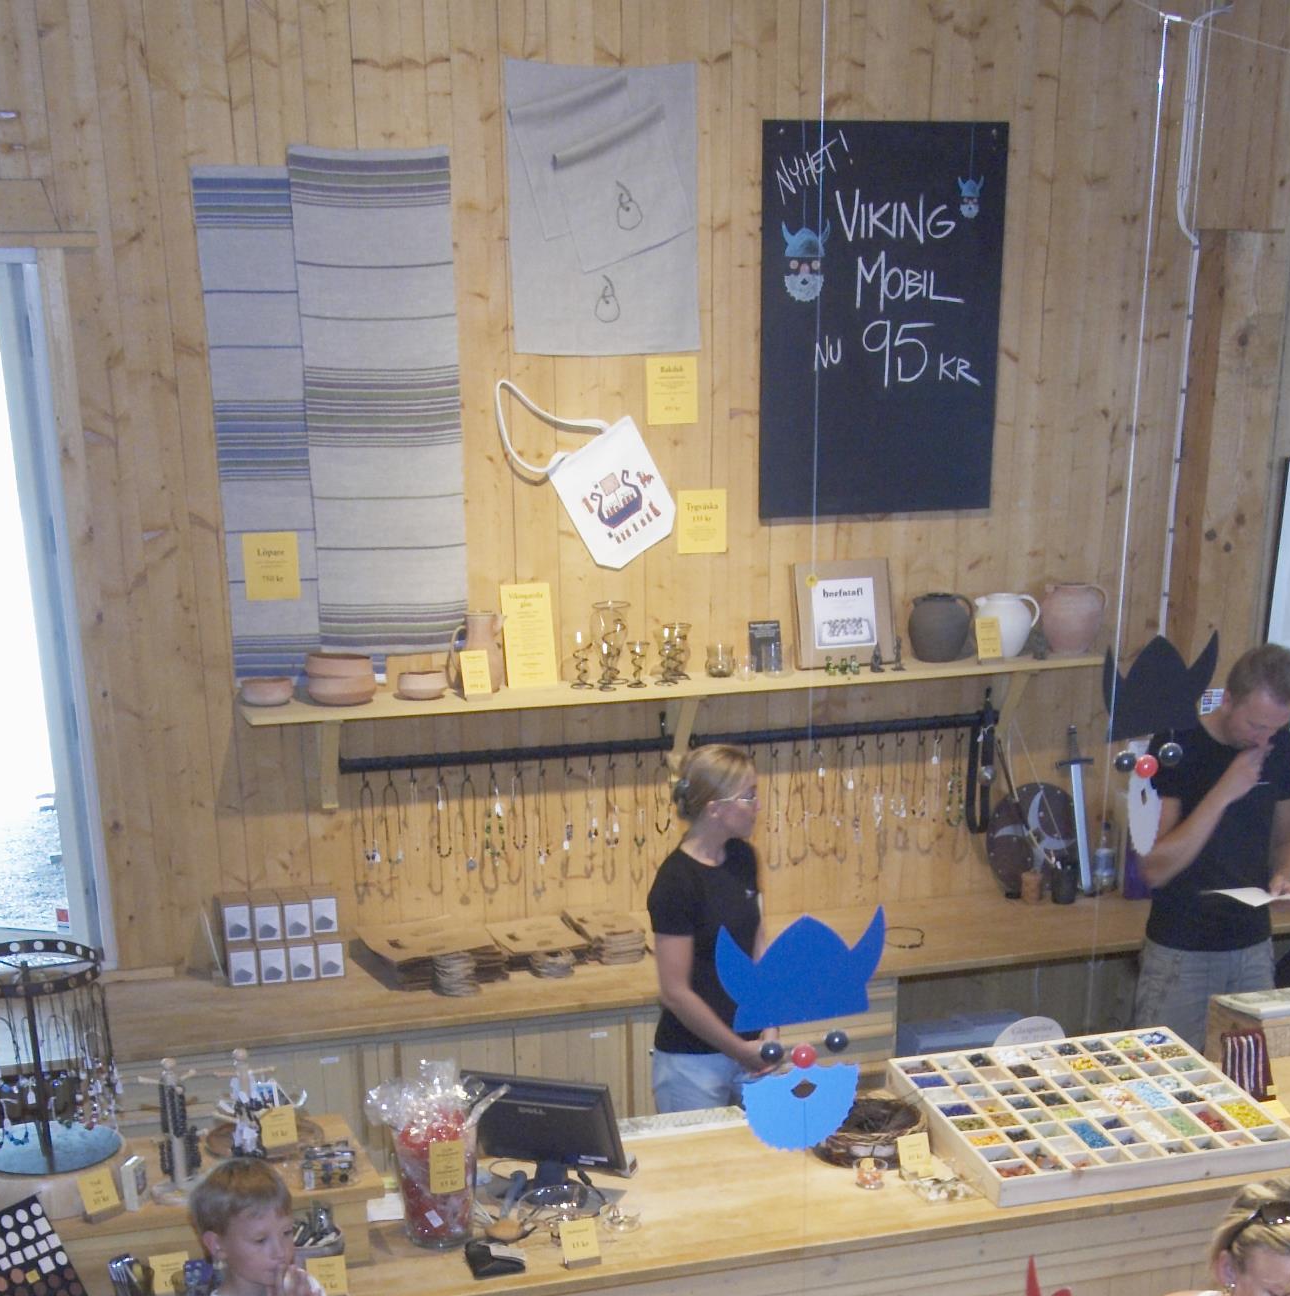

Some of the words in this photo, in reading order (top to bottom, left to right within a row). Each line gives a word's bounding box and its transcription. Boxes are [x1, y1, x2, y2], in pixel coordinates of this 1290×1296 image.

[776, 130, 854, 205] NYHET!
[835, 188, 957, 245] VIKING
[855, 250, 965, 312] MOBIL
[813, 335, 842, 371] NU
[862, 319, 936, 388] 95
[938, 353, 981, 387] KR
